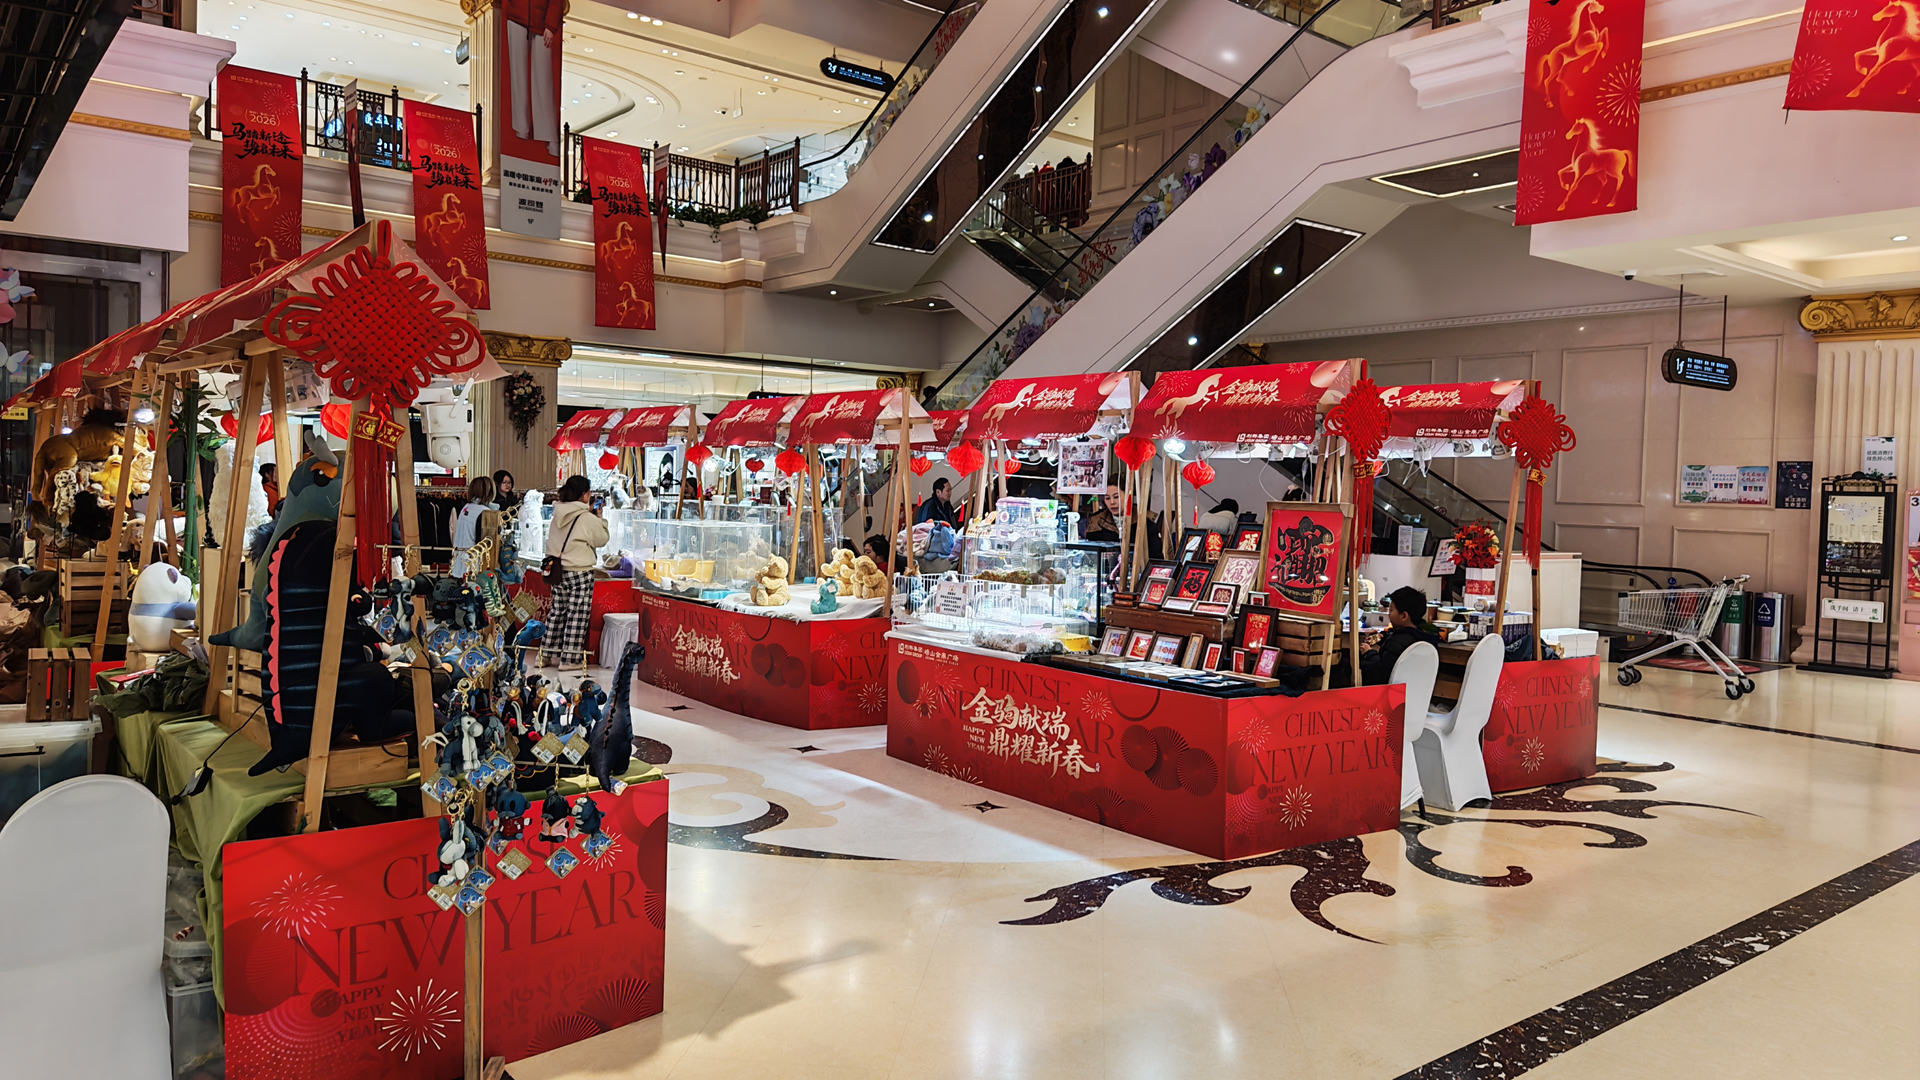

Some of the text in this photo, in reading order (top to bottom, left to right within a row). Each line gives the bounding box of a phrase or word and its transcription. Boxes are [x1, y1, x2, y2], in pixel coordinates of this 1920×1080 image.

[250, 113, 277, 126] 2026
[434, 147, 458, 159] 2026
[609, 179, 630, 189] 2026
[670, 623, 724, 659] 金驹献瑞
[685, 652, 739, 686] 鼎耀新春
[973, 664, 1071, 706] CHINESE
[1525, 674, 1578, 698] CHINESE
[961, 687, 1071, 742] 金驹献瑞
[1284, 707, 1361, 738] CHINESE
[1503, 703, 1548, 735] NEW
[962, 724, 986, 736] HAPPY
[969, 734, 986, 744] NEW
[966, 741, 986, 752] YEAR
[986, 727, 1096, 780] 鼎耀新春
[1250, 736, 1390, 787] NEW YEAR
[289, 907, 465, 997] NEW
[487, 869, 640, 955] YEAR
[339, 984, 386, 1006] APPY
[342, 1003, 386, 1024] NEW
